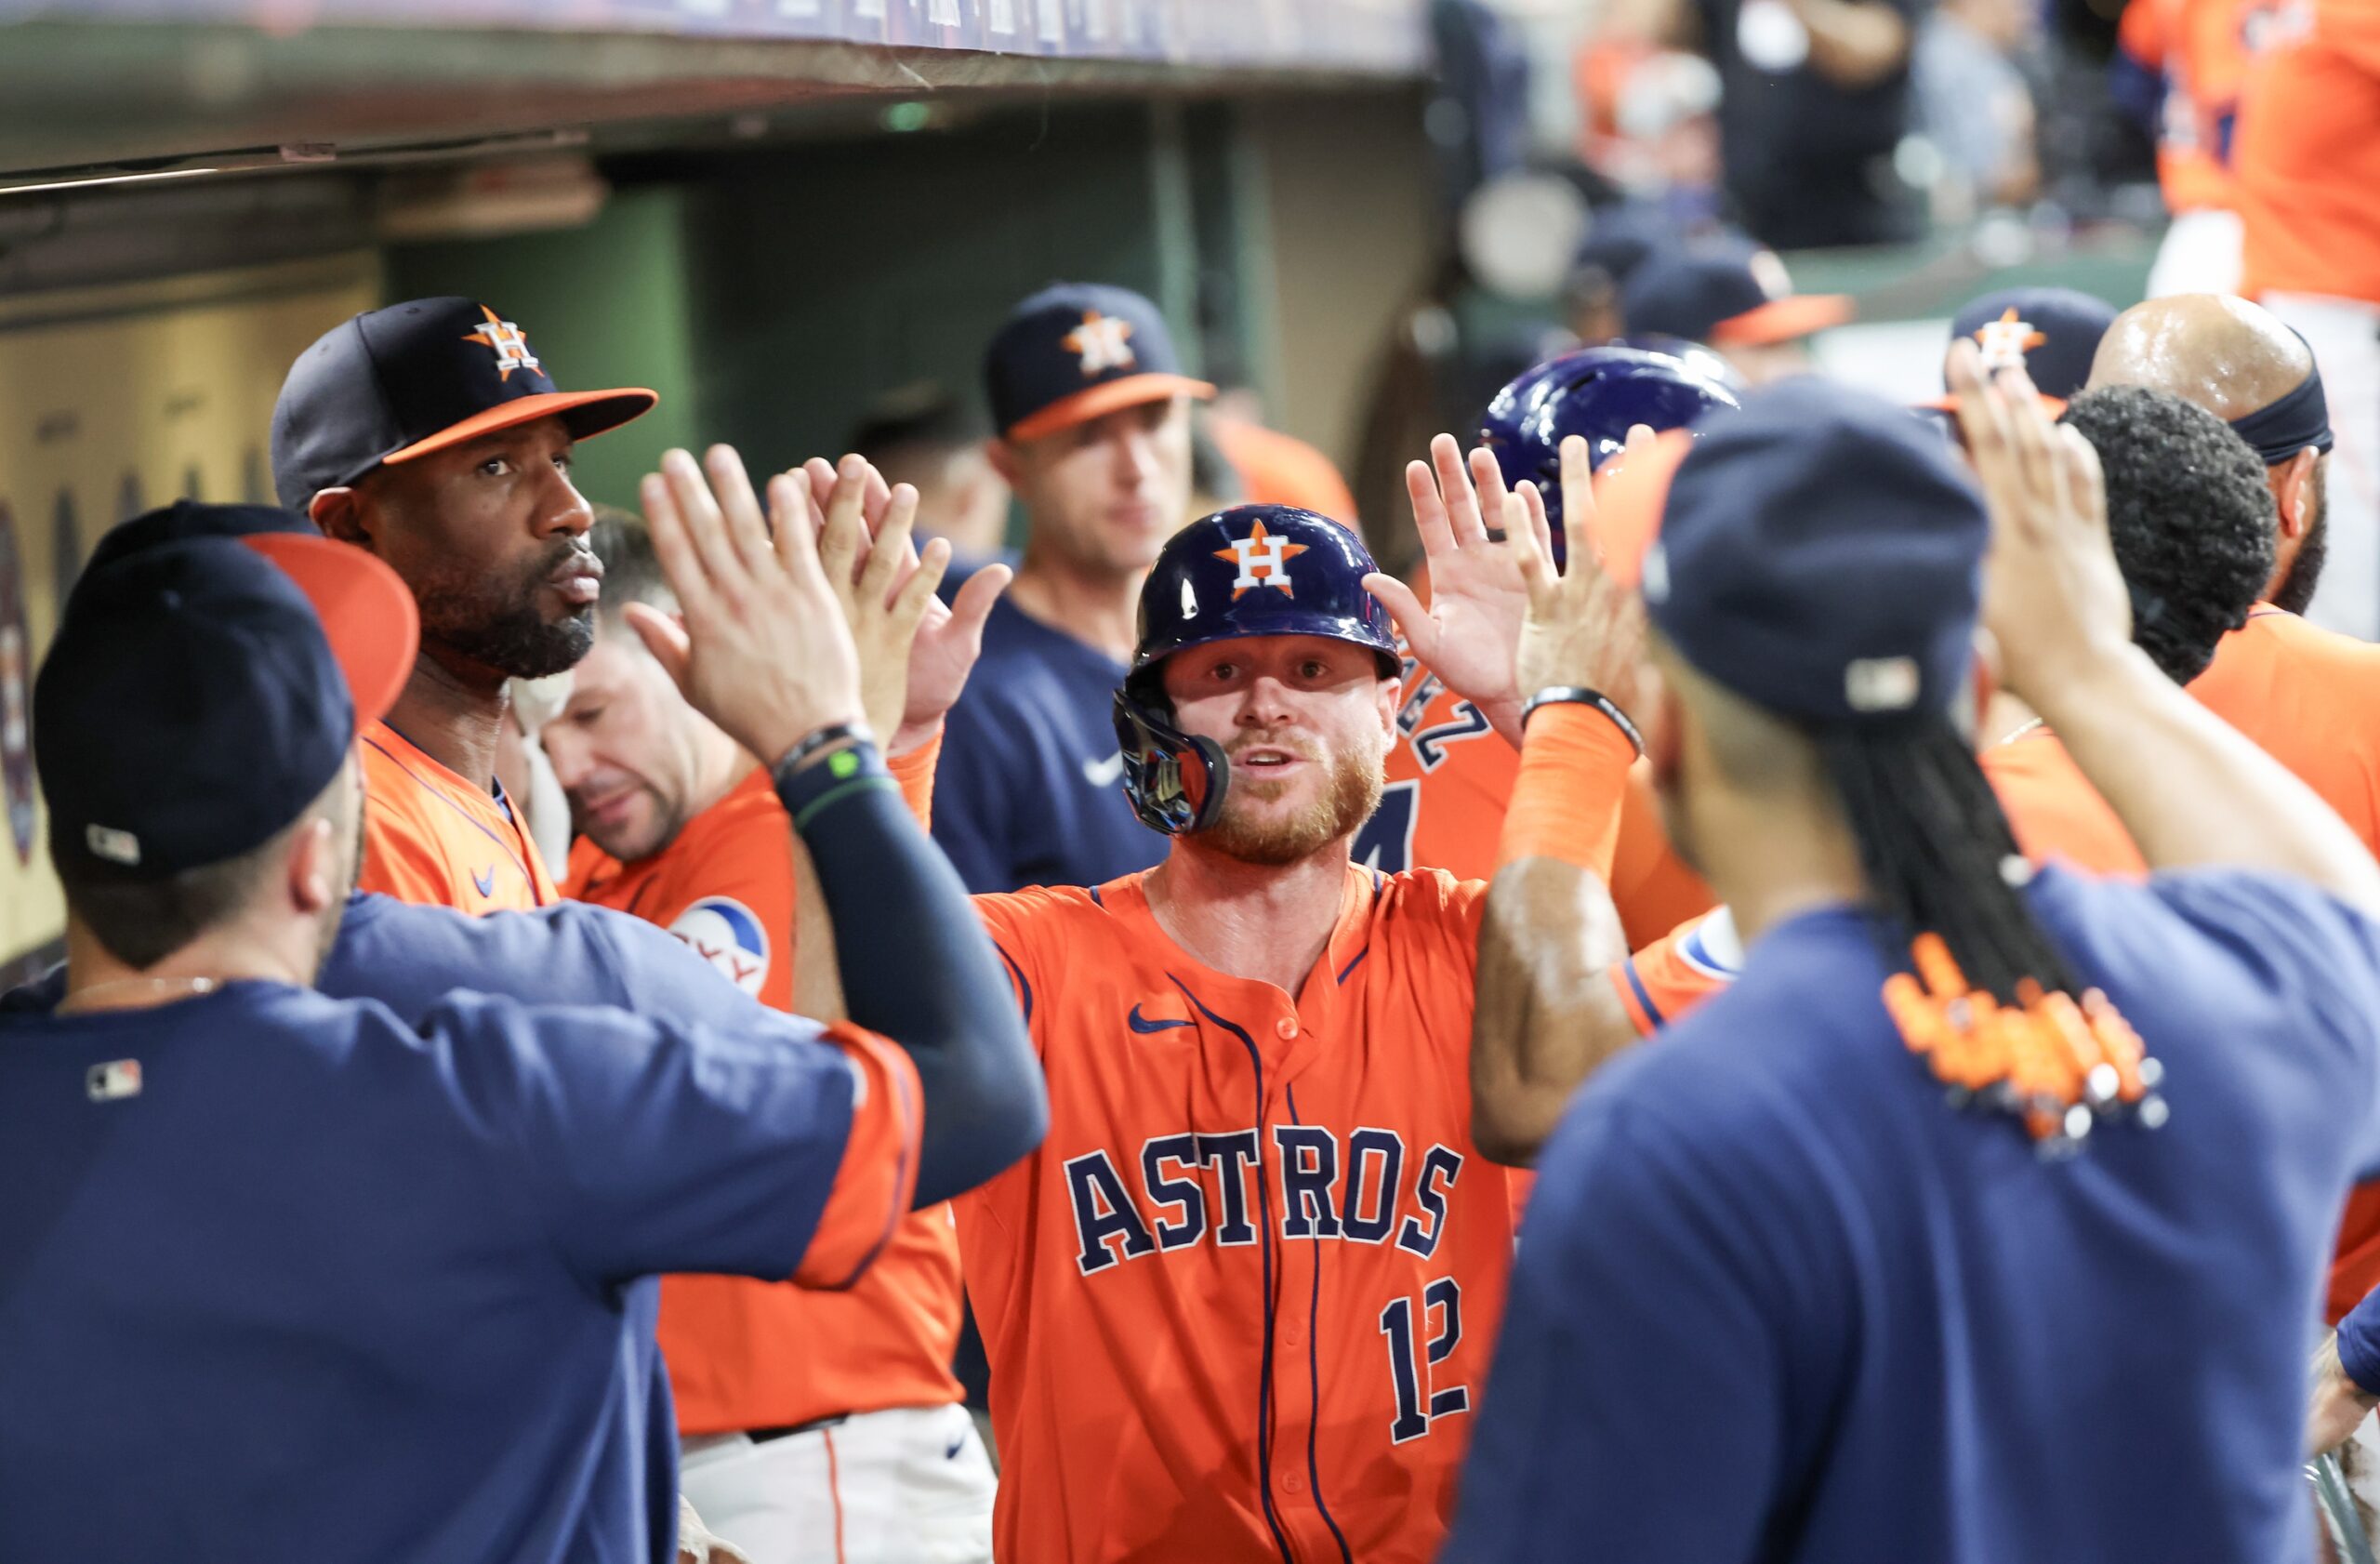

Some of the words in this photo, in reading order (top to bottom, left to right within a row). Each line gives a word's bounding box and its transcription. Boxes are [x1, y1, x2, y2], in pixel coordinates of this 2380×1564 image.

[473, 320, 539, 373] H
[1230, 535, 1293, 590] H
[1063, 1124, 1465, 1278] ASTROS
[1379, 1275, 1471, 1445] 12
